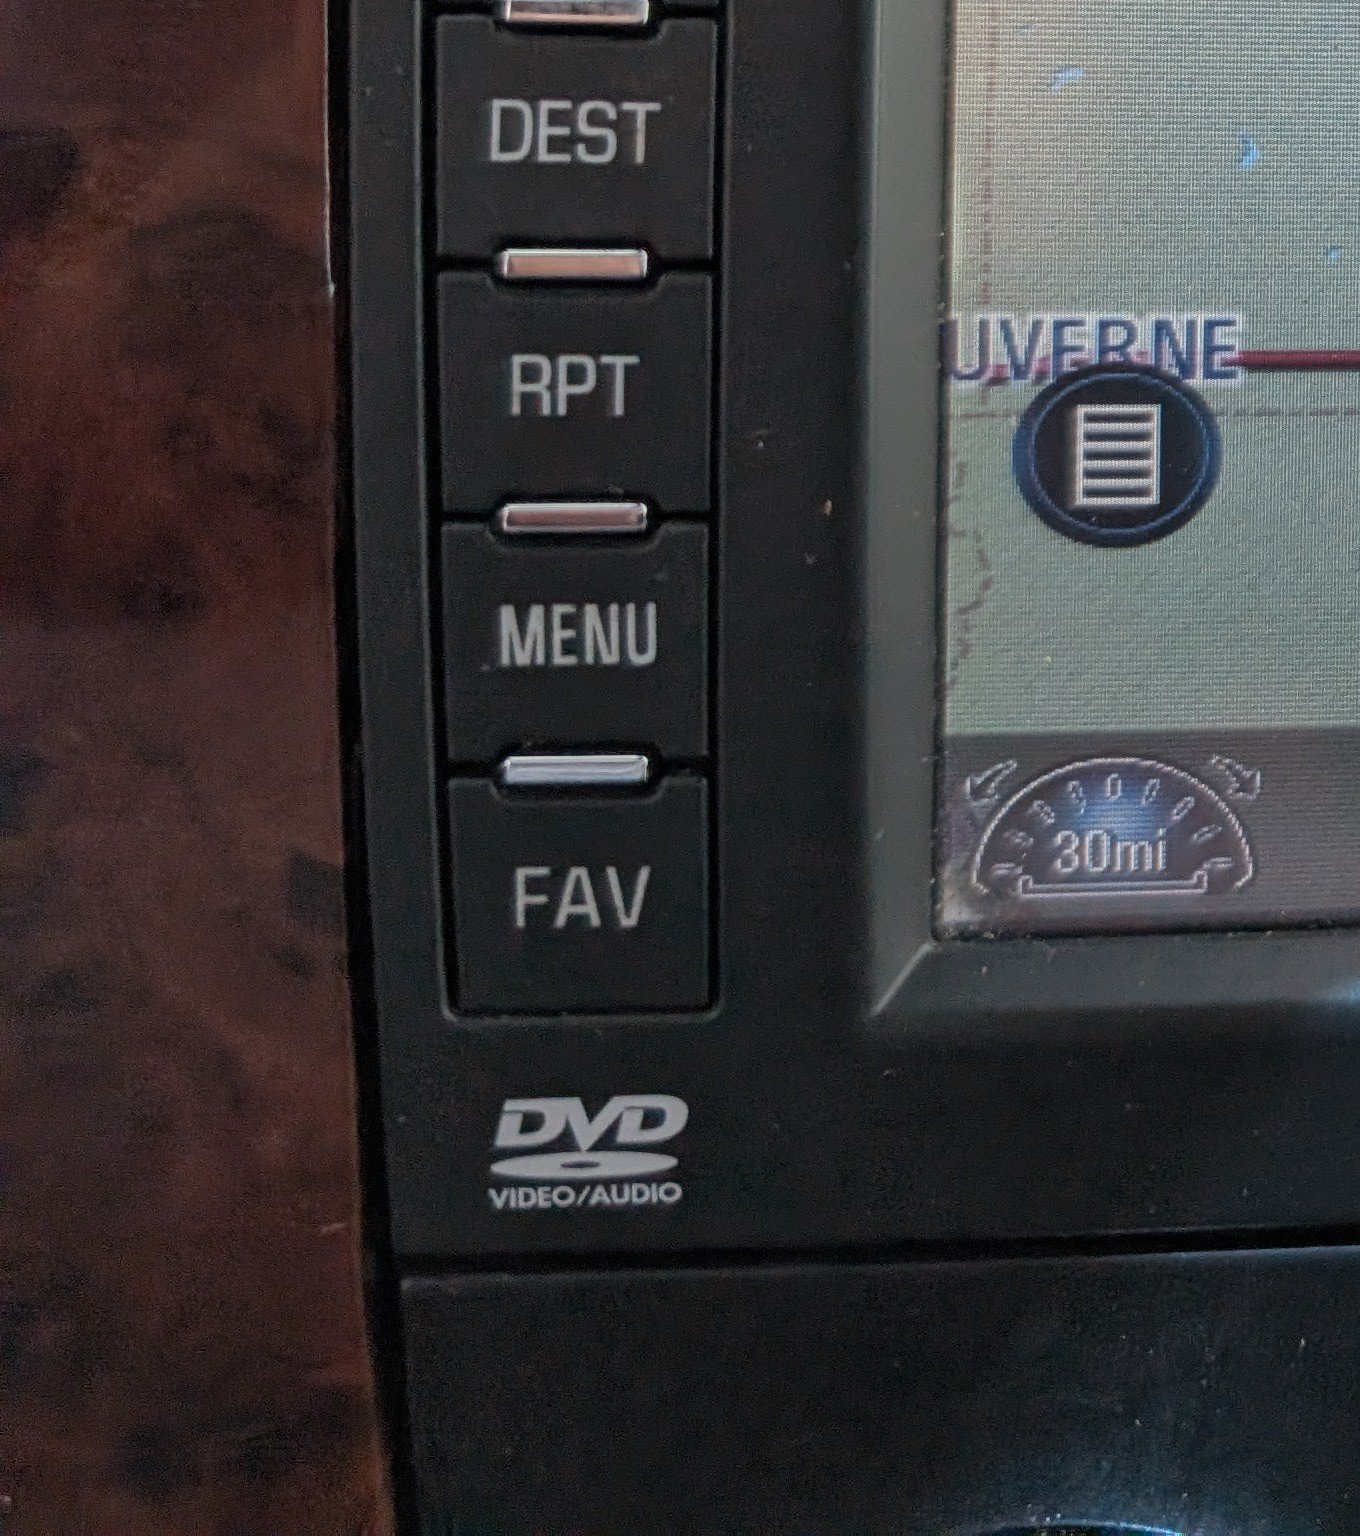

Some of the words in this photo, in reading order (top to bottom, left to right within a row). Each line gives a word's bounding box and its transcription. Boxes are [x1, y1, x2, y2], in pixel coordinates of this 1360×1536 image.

[490, 99, 661, 164] DEST
[511, 354, 639, 417] RPT
[501, 603, 658, 667] MENU
[1054, 829, 1168, 874] 30mi
[514, 866, 651, 928] FAV
[495, 1093, 689, 1152] DVD
[488, 1181, 684, 1210] VIDEO/AUDIO
